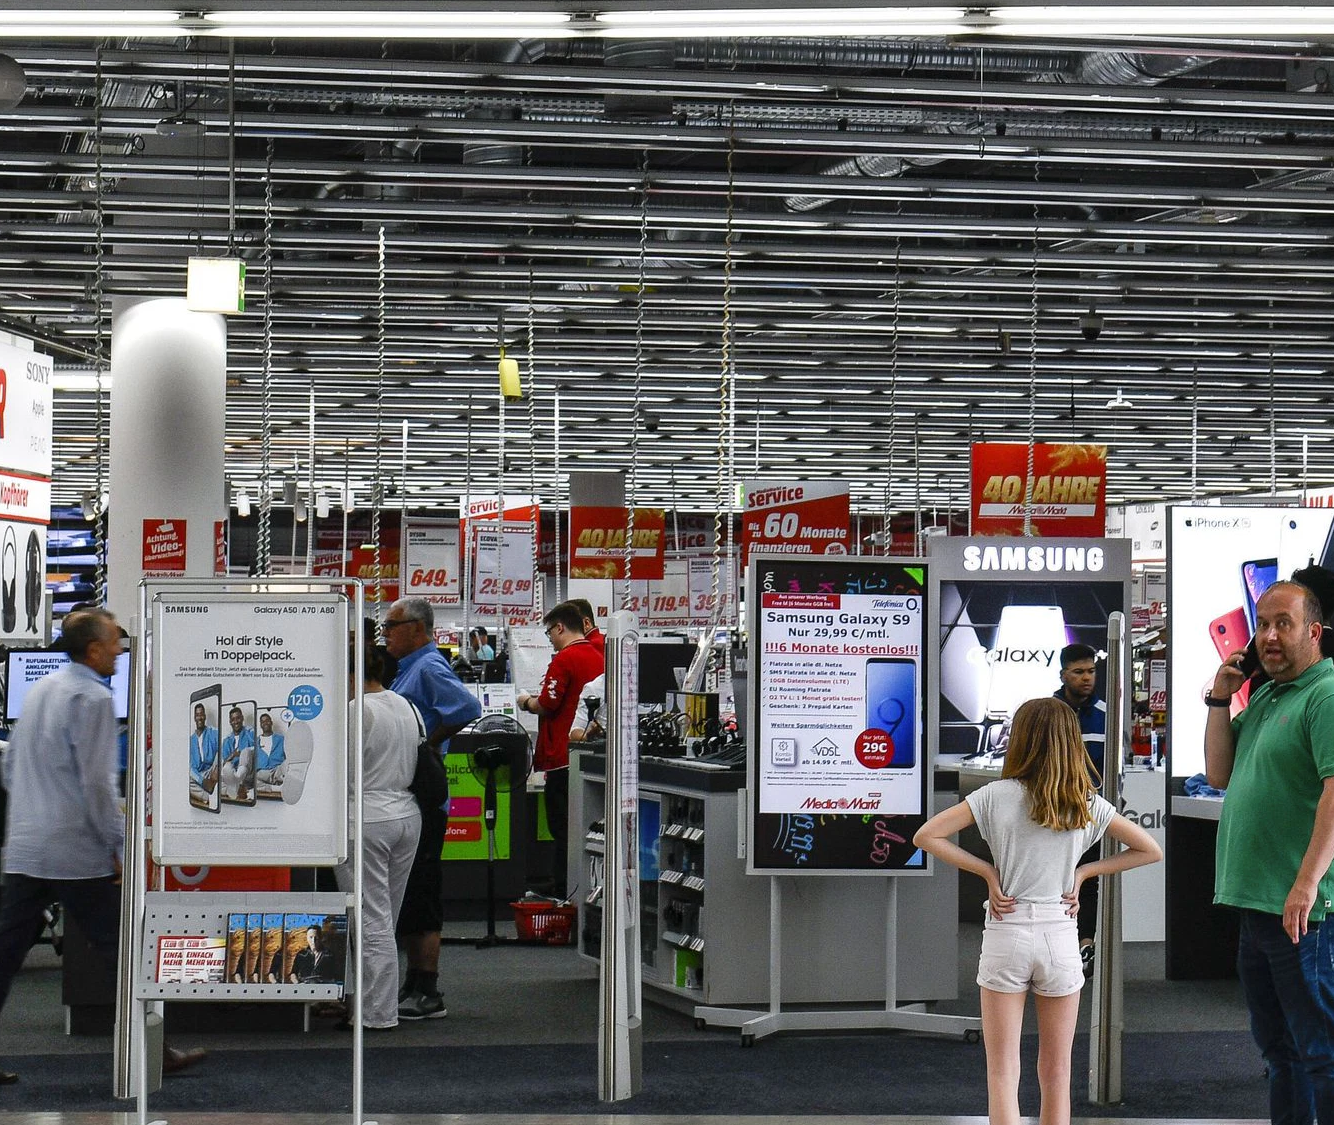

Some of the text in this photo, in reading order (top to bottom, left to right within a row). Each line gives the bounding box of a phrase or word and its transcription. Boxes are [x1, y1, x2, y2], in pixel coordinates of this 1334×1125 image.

[26, 361, 50, 385] SONY
[982, 475, 1101, 505] 40 JAHRE
[748, 486, 804, 508] Service
[764, 512, 799, 539] 60
[799, 526, 847, 539] Monate
[1194, 518, 1230, 528] iPhone
[578, 528, 604, 548] 40
[151, 542, 182, 554] Video-
[748, 542, 813, 554] finanzieren.
[963, 545, 1104, 572] SAMSUNG
[165, 606, 209, 614] SAMSUNG
[254, 606, 282, 616] Galaxy
[767, 612, 911, 627] Samsung Galaxy S9
[788, 628, 810, 637] Nur
[814, 628, 848, 639] 29,99
[215, 635, 284, 649] Hol dir Style
[791, 643, 839, 654] Monate
[843, 644, 919, 655] kostenlos!!!
[204, 649, 296, 663] im Doppelpack.
[290, 694, 311, 706] 120
[186, 951, 213, 959] EINFACH
[185, 959, 205, 967] MEHR
